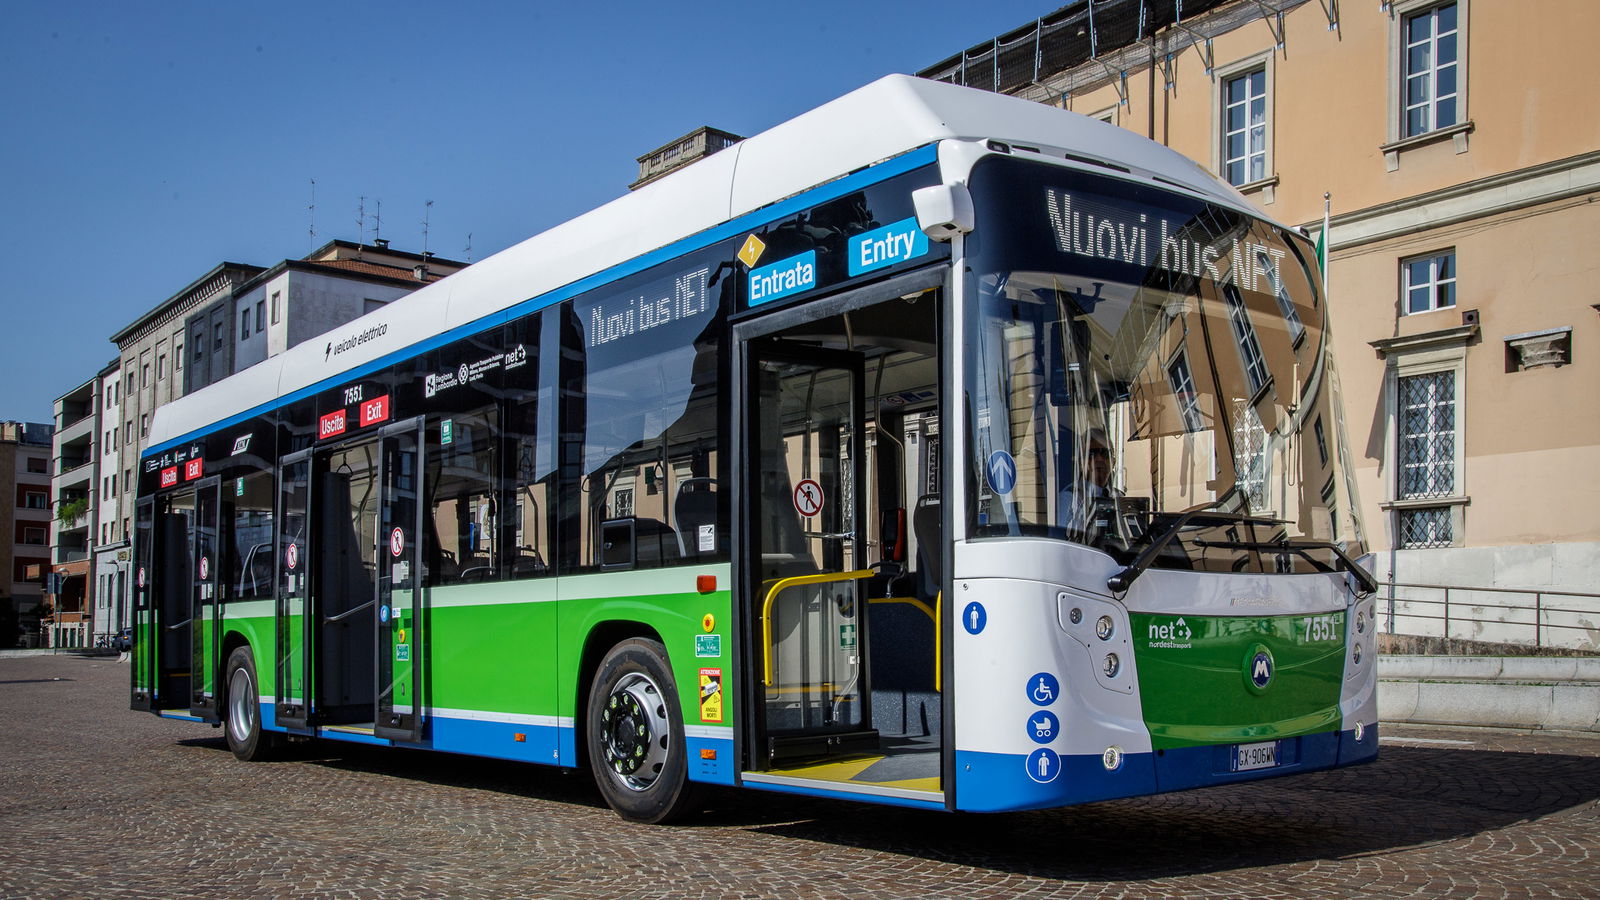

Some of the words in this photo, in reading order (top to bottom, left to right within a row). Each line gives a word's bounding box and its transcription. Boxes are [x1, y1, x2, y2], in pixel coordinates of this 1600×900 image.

[861, 228, 916, 267] Entry
[1048, 189, 1146, 266] Nuovi
[1161, 219, 1219, 281] bus
[1233, 238, 1286, 297] NET
[751, 260, 813, 301] Entrata
[591, 299, 635, 347] Nuovi
[639, 296, 671, 331] bus
[675, 268, 709, 319] NET
[334, 334, 357, 356] veicolo
[357, 323, 388, 345] elettrico
[505, 348, 518, 364] net
[435, 372, 453, 383] Regione
[435, 379, 458, 391] Lombardia
[344, 384, 363, 405] 7551
[366, 401, 382, 421] Exit
[322, 414, 344, 435] Uscita
[162, 469, 177, 484] Uscita
[189, 461, 199, 476] Exit
[1149, 621, 1176, 640] net
[1303, 617, 1337, 642] 7551
[1253, 660, 1270, 678] M
